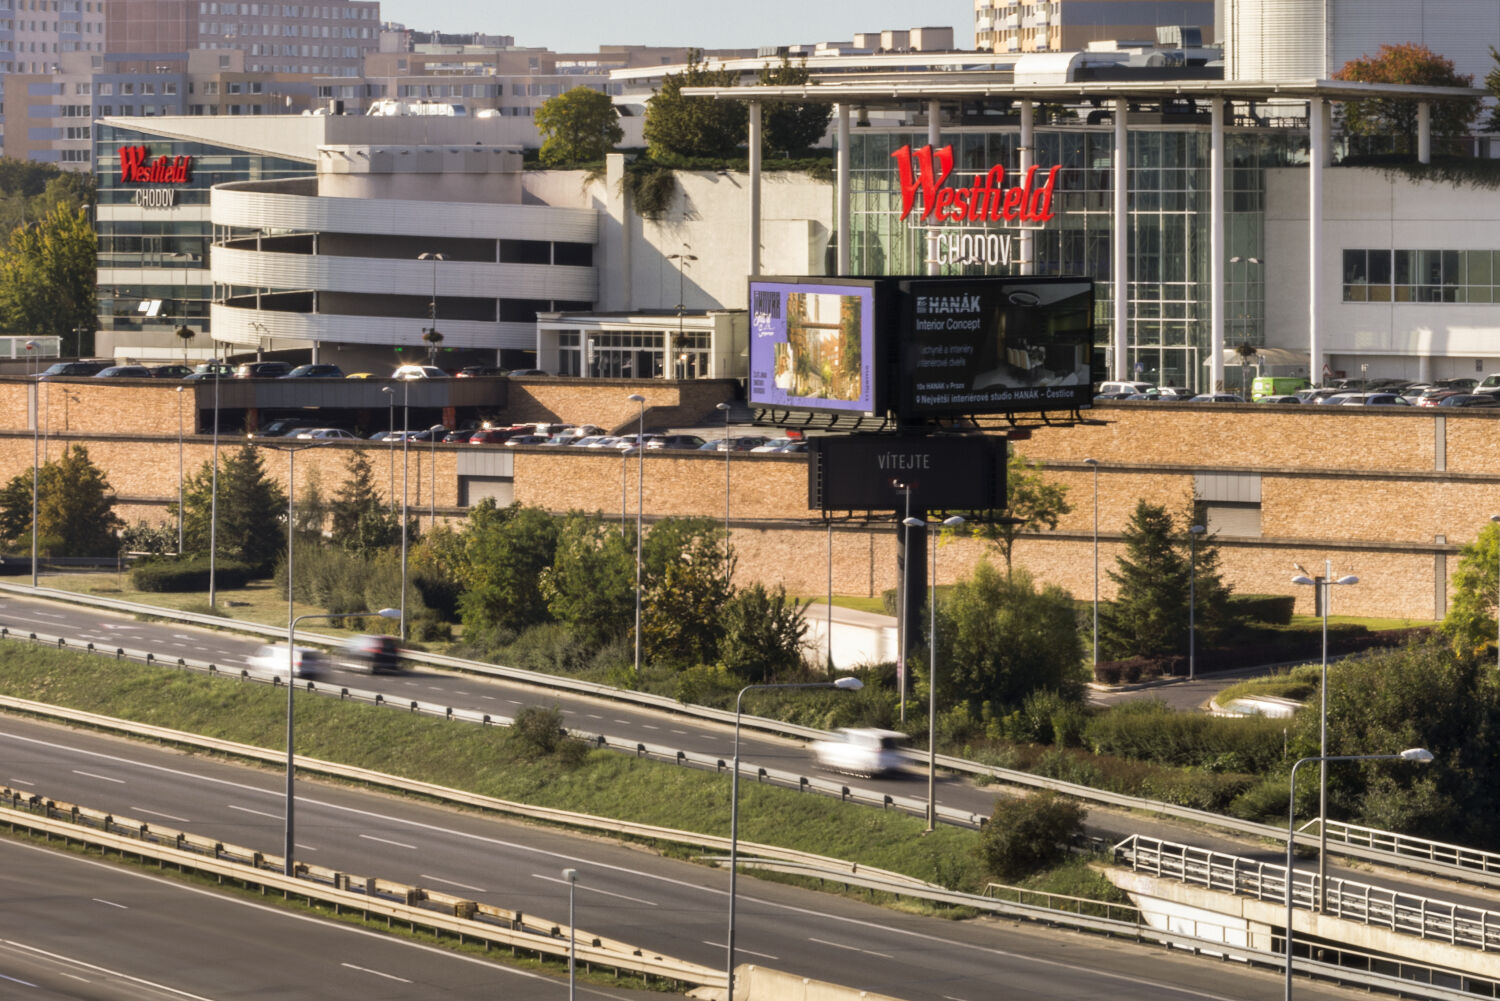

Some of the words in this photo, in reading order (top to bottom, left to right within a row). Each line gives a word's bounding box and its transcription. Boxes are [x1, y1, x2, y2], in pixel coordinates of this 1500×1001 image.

[117, 145, 190, 183] Westfield
[891, 143, 1063, 223] Westfield
[136, 188, 175, 207] CHODOV
[936, 233, 1012, 266] CHODOV
[929, 292, 981, 314] HANÁK
[916, 318, 945, 331] Interior
[946, 317, 981, 332] Concept
[990, 391, 1012, 401] studio
[1013, 388, 1039, 400] HANÁK
[1046, 387, 1075, 399] Čestlice
[877, 451, 931, 470] VÍTEJTE
